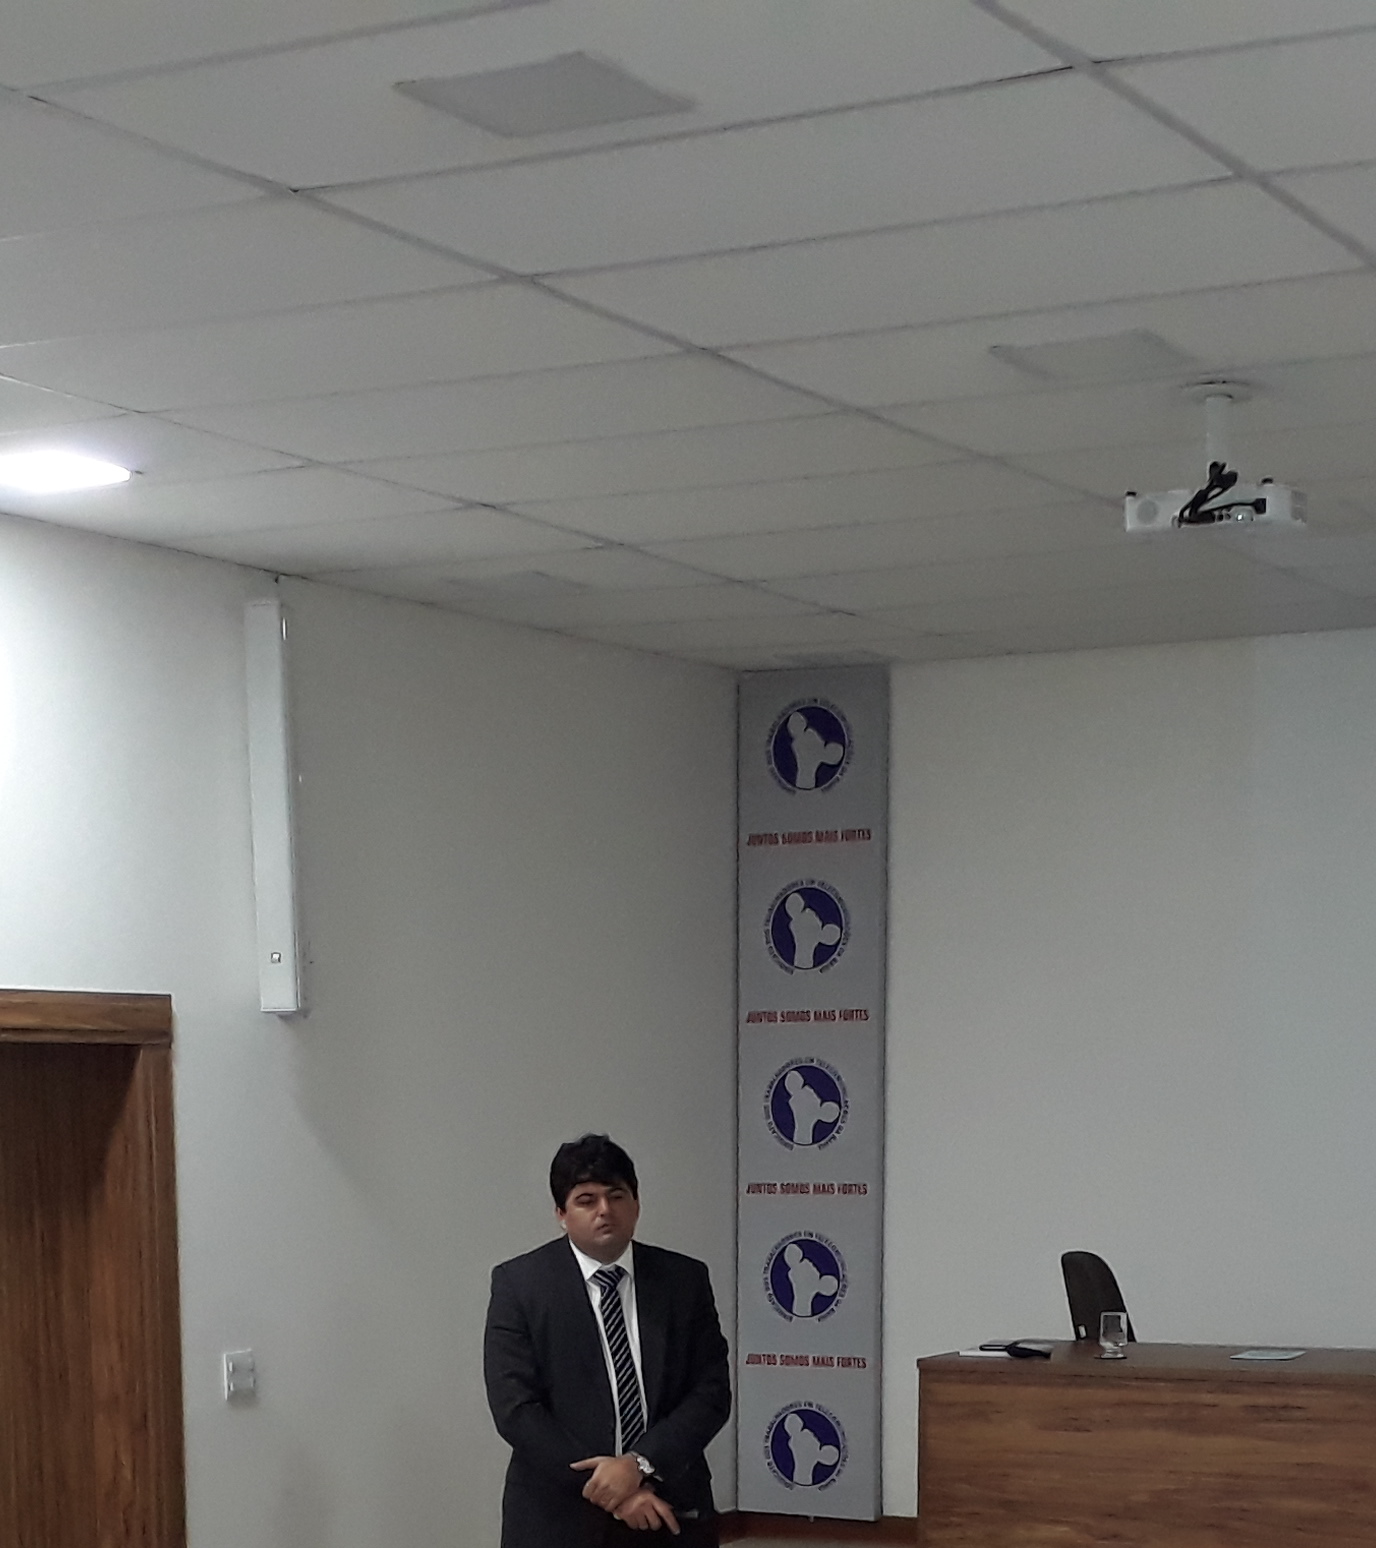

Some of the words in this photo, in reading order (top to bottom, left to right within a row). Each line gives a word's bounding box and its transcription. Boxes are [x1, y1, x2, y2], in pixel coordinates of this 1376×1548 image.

[780, 1009, 811, 1022] SOMOS
[746, 1182, 778, 1195] JUNTOS
[780, 1182, 810, 1195] SOMOS
[812, 1183, 835, 1195] MAIS
[837, 1183, 868, 1195] FORTES
[745, 1353, 777, 1366] JUNTOS
[779, 1354, 810, 1367] SOMOS
[812, 1355, 834, 1368] MAIS
[837, 1356, 867, 1369] FORTES
